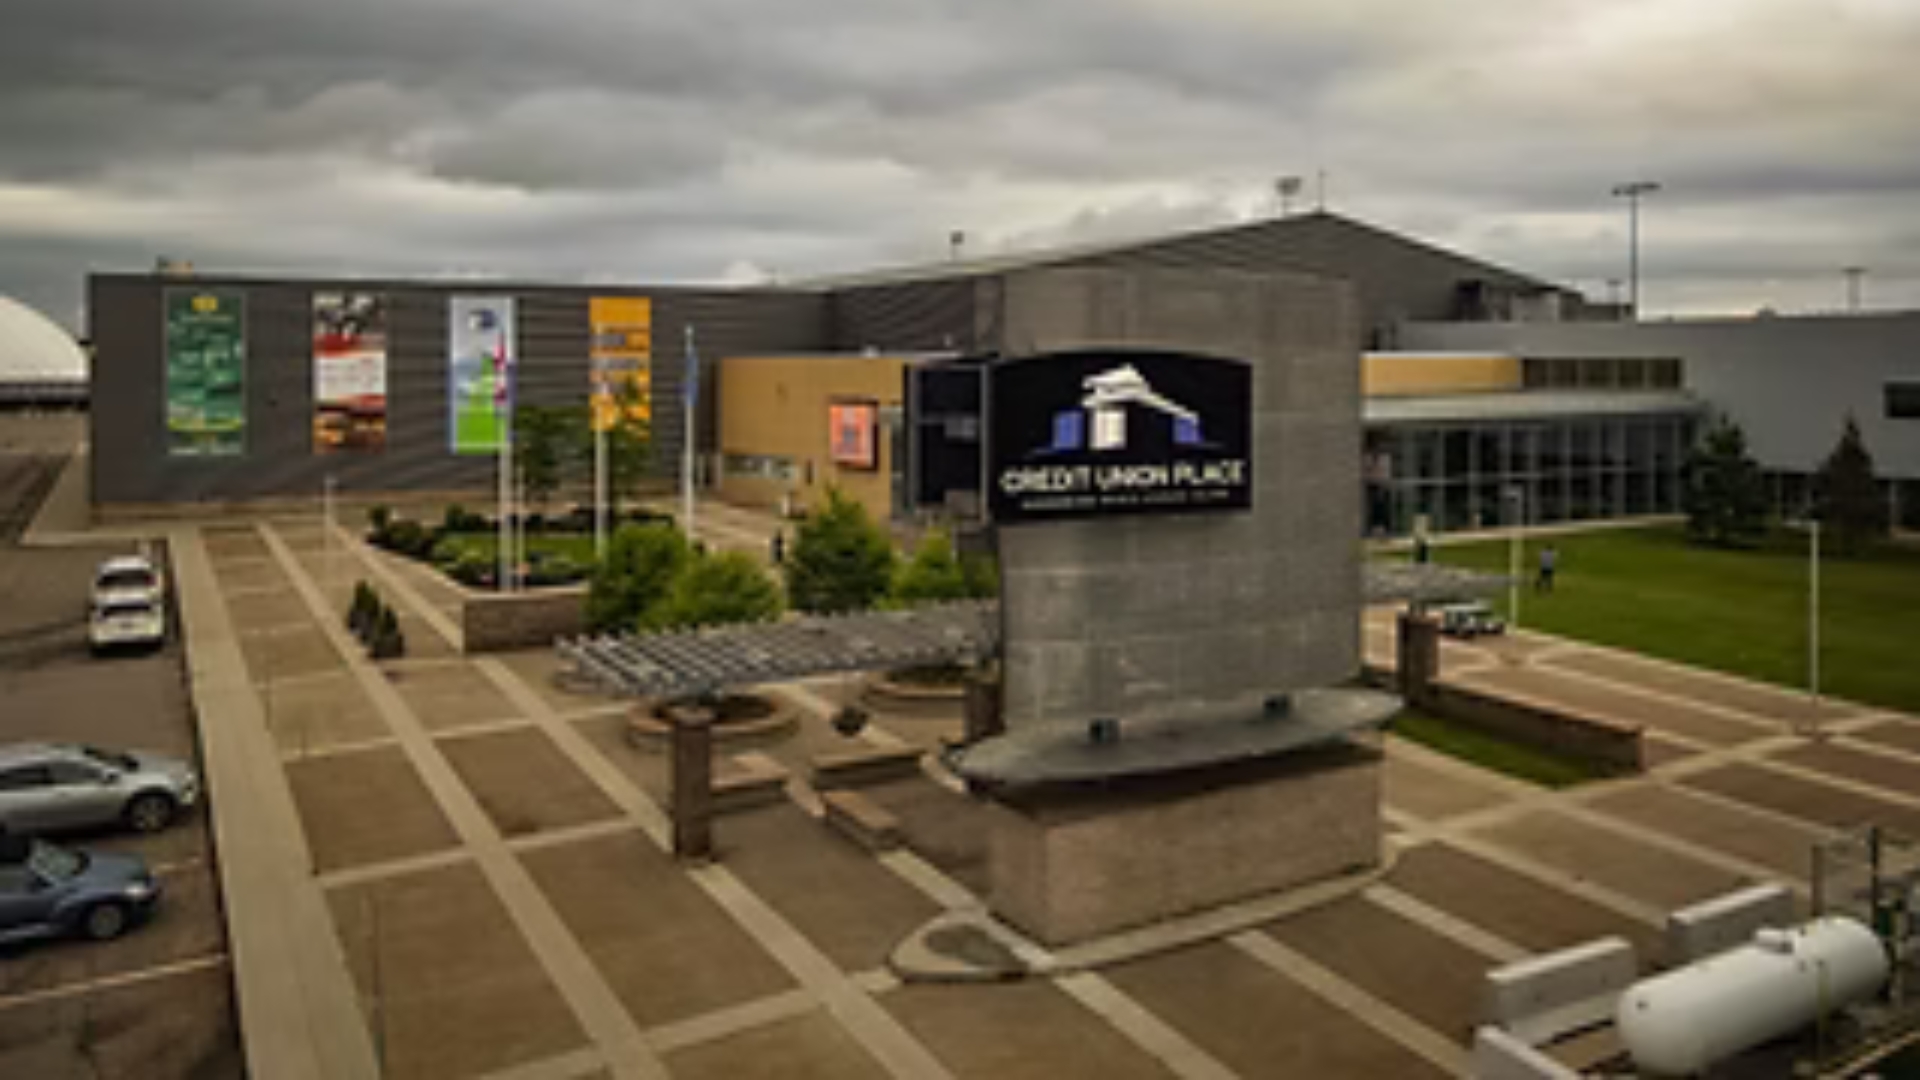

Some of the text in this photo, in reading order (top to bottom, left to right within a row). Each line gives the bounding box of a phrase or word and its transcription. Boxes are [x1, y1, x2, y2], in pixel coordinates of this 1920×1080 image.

[1001, 459, 1244, 492] CREDIT UNION PLACE
